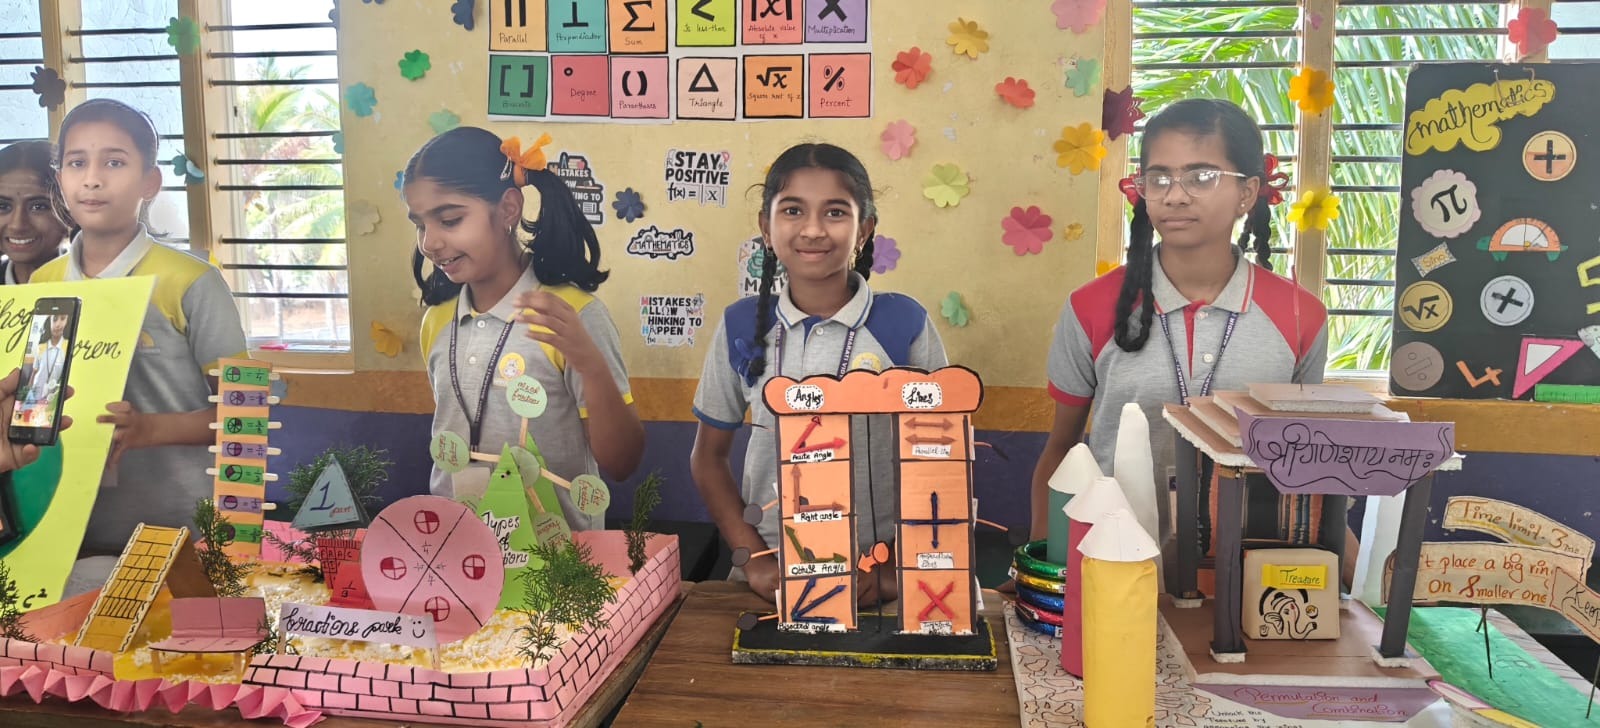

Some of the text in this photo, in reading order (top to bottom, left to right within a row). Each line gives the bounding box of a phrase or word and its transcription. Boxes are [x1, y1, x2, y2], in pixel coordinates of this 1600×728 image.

[499, 32, 528, 44] Parallel
[624, 37, 643, 46] Sum
[688, 97, 723, 112] Triangle
[820, 97, 853, 108] Percent
[675, 151, 721, 170] STAY
[665, 168, 730, 186] POSITIVE
[634, 238, 690, 251] MATHEMATICS
[641, 296, 692, 307] MISTAKES
[642, 315, 702, 327] THINKING TO
[843, 330, 856, 361] BHARATI
[793, 388, 824, 407] Angles
[907, 386, 934, 405] Lines
[310, 480, 336, 511] 1
[800, 511, 840, 522] Right angle
[1448, 499, 1502, 524] Time
[480, 511, 520, 537] Types
[498, 531, 510, 551] of
[1440, 553, 1477, 574] place
[1484, 558, 1496, 570] a
[1503, 552, 1524, 583] big
[1428, 574, 1548, 604] On Smaller one
[1234, 686, 1378, 703] Permutation and
[1312, 703, 1409, 717] Combination
